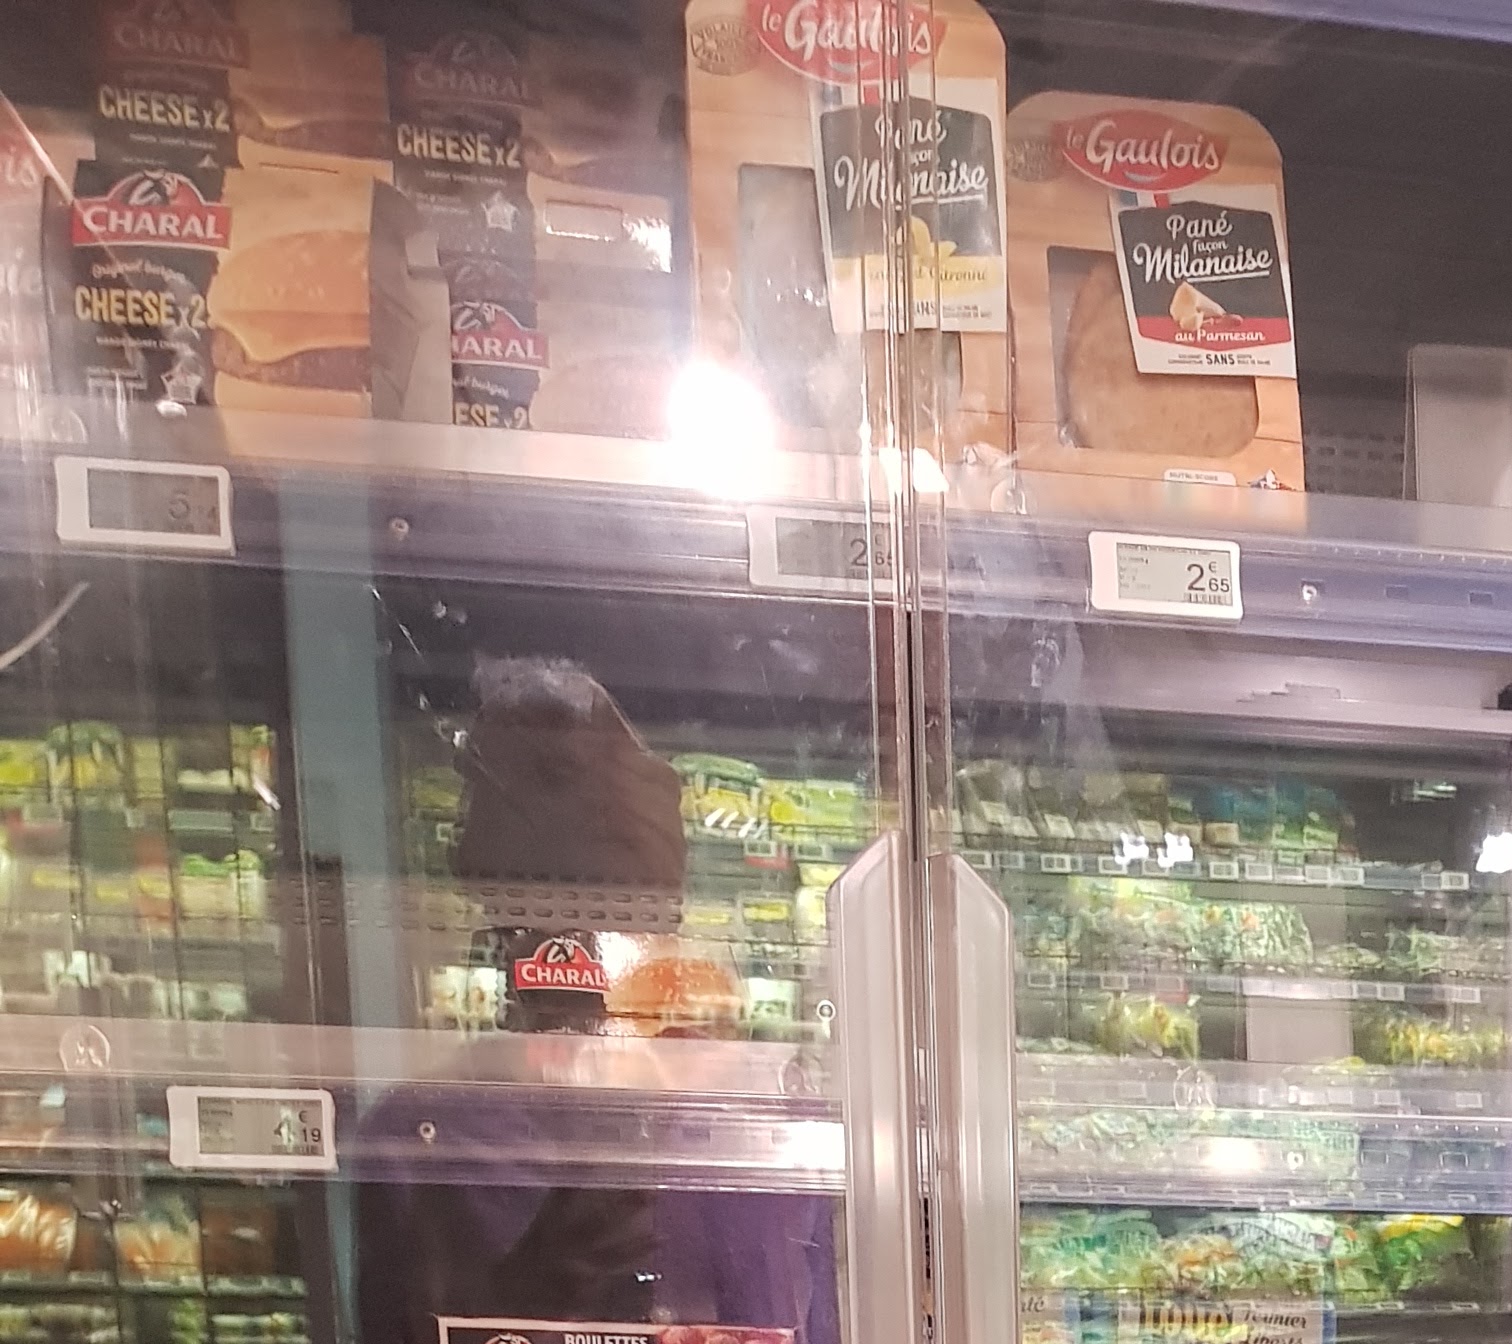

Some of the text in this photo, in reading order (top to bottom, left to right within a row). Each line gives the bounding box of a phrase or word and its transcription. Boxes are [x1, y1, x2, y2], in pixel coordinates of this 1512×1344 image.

[100, 84, 200, 128] CHEESE
[397, 124, 492, 165] CHEESE
[1066, 125, 1084, 148] le
[1085, 119, 1220, 175] Gaulois
[82, 206, 224, 240] CHARAL
[1166, 210, 1233, 241] Pané
[1193, 239, 1228, 253] façon
[1133, 243, 1273, 284] Milanaise
[75, 284, 175, 328] CHEESE
[452, 335, 543, 360] ARAL
[1174, 328, 1266, 342] au Parmesan
[1205, 352, 1236, 366] SANS
[1186, 563, 1206, 593] 2
[1208, 577, 1231, 593] 65
[521, 963, 606, 987] CHARAL
